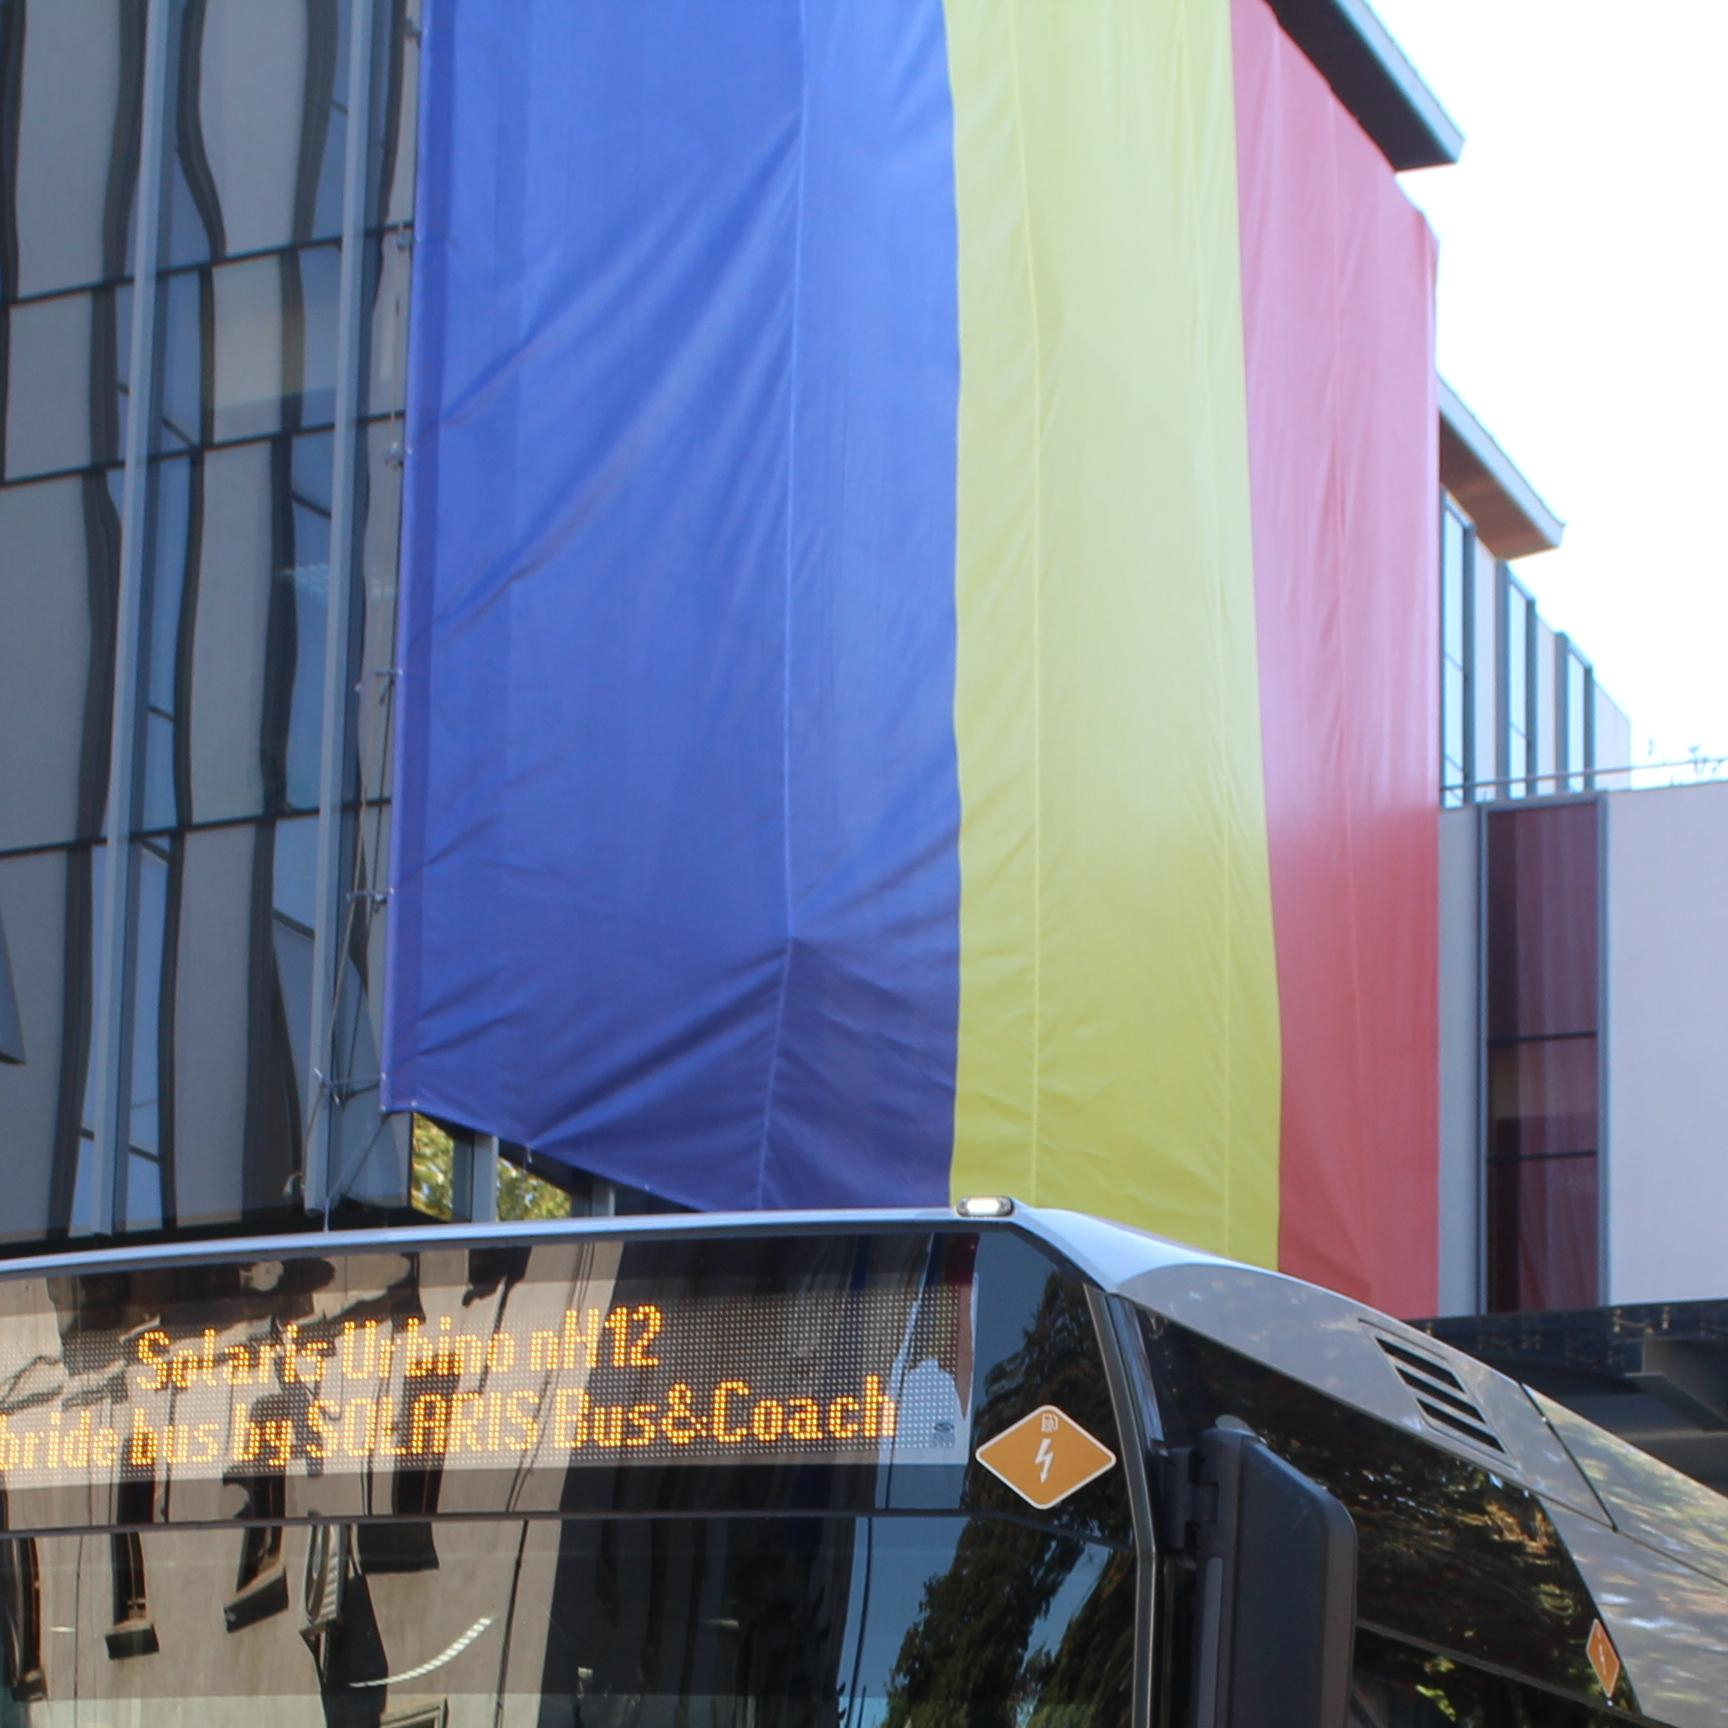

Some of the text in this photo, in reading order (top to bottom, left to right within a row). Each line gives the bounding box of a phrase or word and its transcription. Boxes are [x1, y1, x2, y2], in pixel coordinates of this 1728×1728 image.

[136, 1304, 665, 1391] Solaris Urbino nH12
[130, 1406, 221, 1466] bus
[231, 1402, 294, 1467] by
[304, 1388, 541, 1458] SOLARIS
[553, 1374, 896, 1450] Bus&Coach
